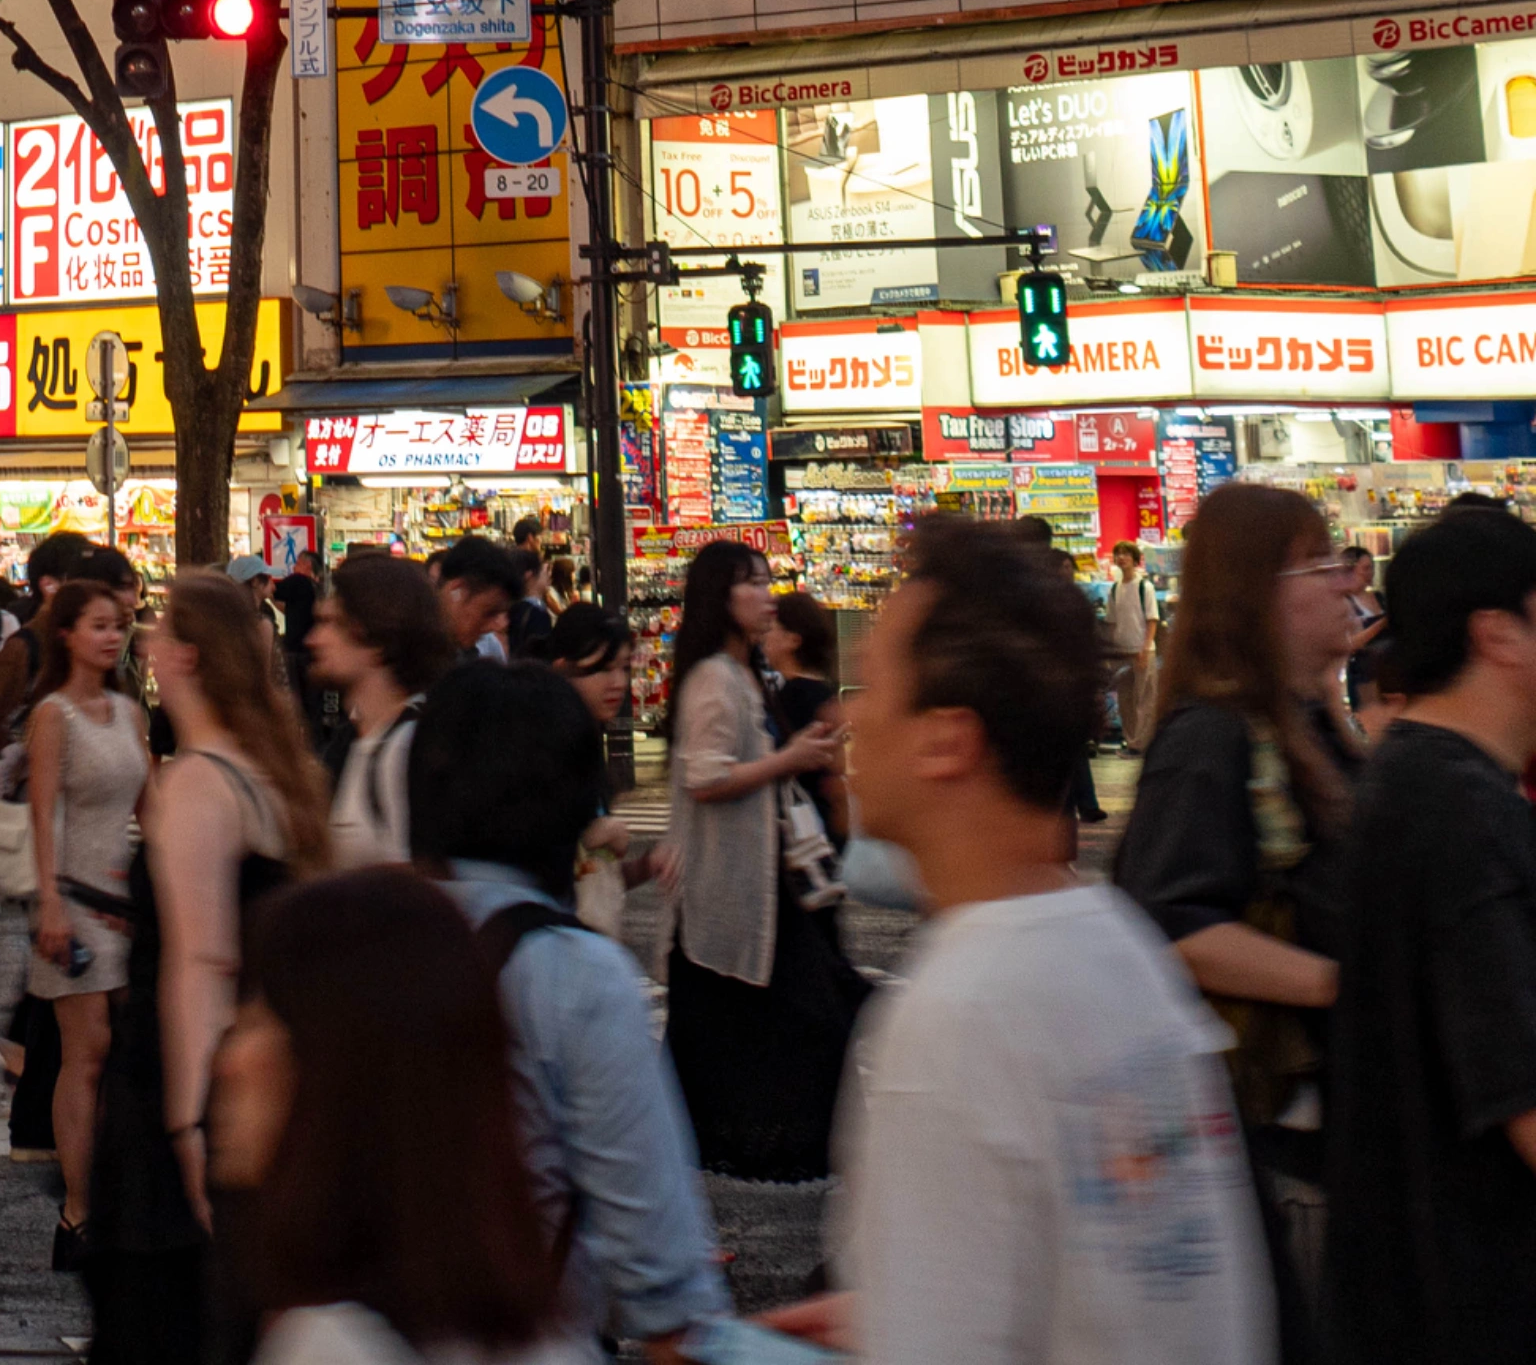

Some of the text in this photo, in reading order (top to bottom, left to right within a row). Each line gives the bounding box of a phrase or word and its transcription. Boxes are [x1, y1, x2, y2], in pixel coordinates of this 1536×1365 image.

[393, 18, 516, 37] Dogenzaka shita
[1057, 44, 1179, 77] ビックカメラ
[738, 80, 852, 106] BicCamera
[1007, 90, 1108, 129] Let's DUO
[661, 151, 678, 162] Tax
[681, 151, 703, 162] Free
[730, 170, 756, 219] 5
[17, 129, 59, 299] 2F
[703, 207, 724, 220] OFF
[807, 205, 833, 221] ASUS
[834, 203, 873, 220] Zenbook
[65, 251, 144, 292] 化妆品
[1196, 335, 1374, 373] ビックカメラ
[1416, 335, 1465, 367] BIC
[787, 354, 915, 391] ビックカメラ
[306, 417, 354, 440] 処方せん
[359, 413, 517, 449] オーエス薬局
[526, 414, 559, 438] OS
[939, 414, 1055, 440] Tax Free Store
[1113, 419, 1124, 433] A
[314, 444, 343, 466] 受付
[378, 452, 484, 467] OS PHARMACY
[517, 444, 563, 465] クスリ
